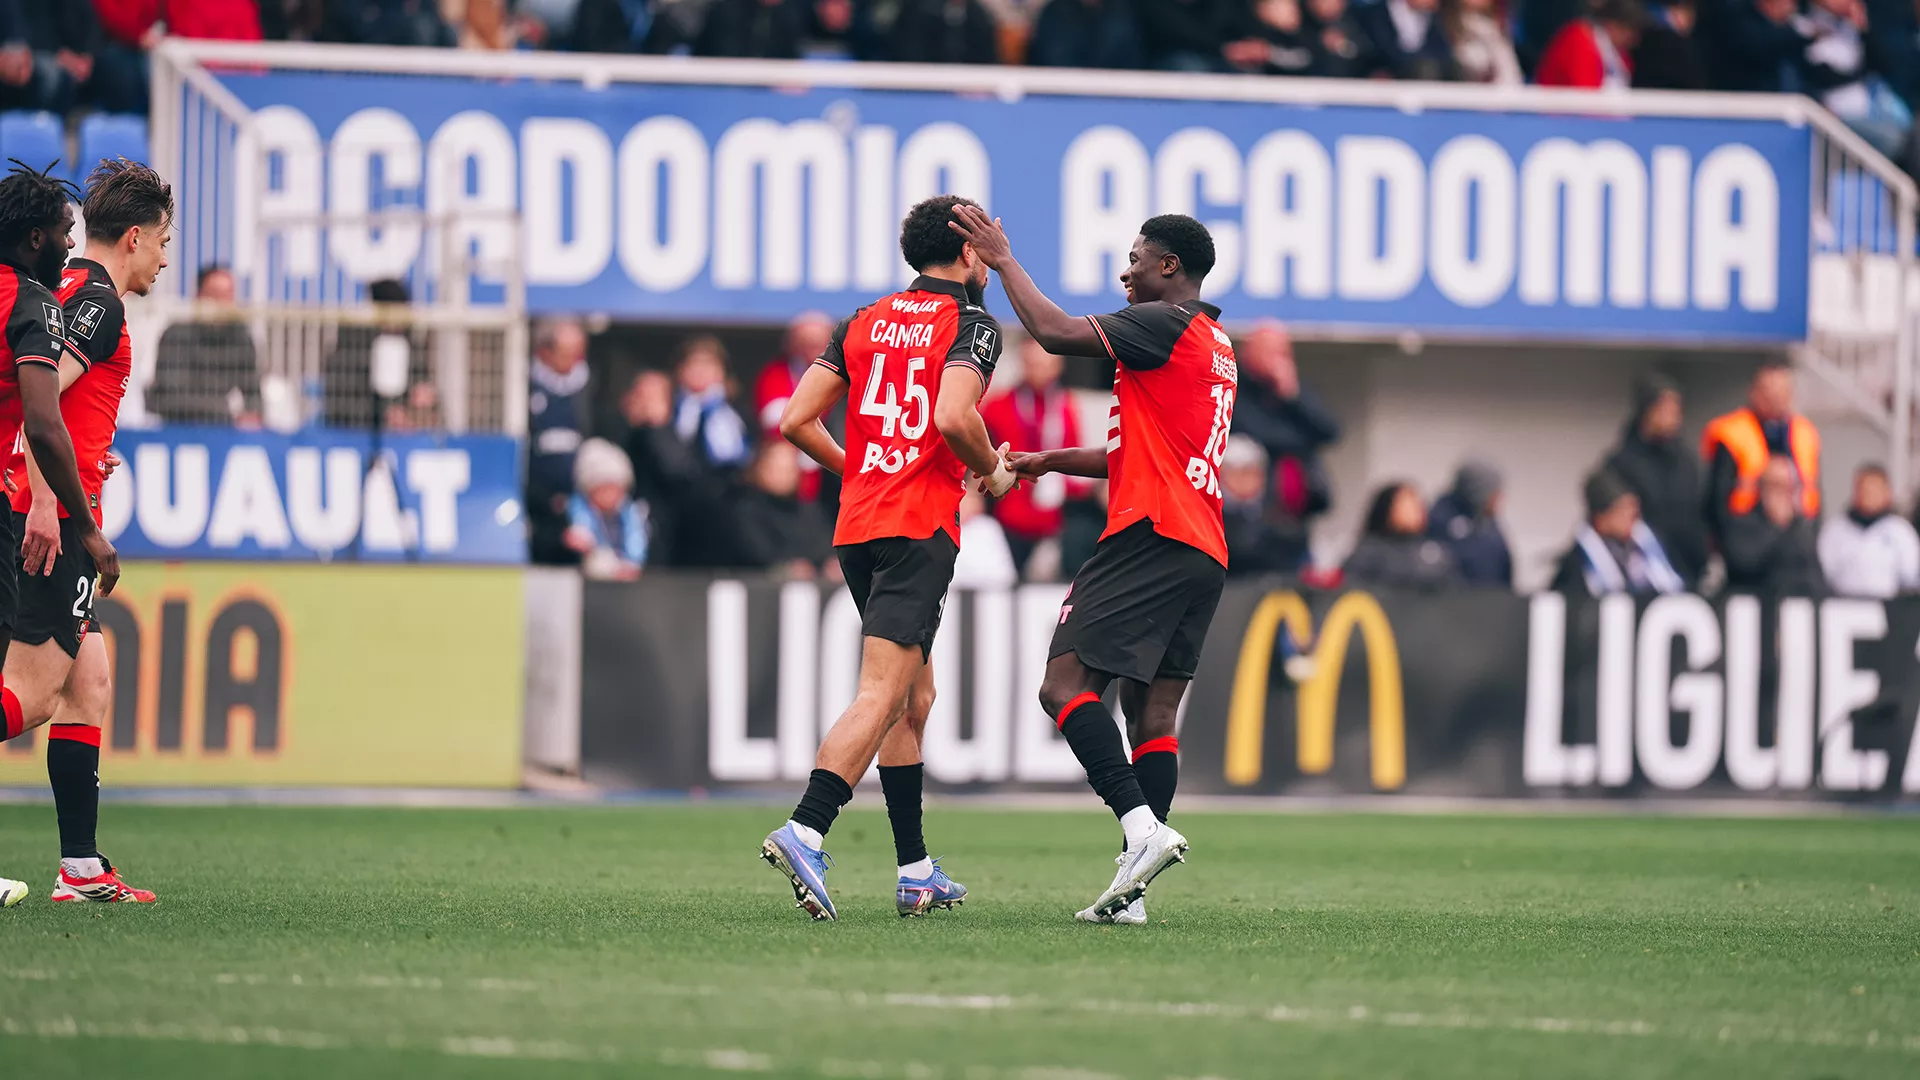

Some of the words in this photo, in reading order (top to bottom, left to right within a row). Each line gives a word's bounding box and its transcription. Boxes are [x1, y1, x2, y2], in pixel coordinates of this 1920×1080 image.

[1060, 125, 1780, 312] ACADOMIA
[859, 353, 930, 440] 45
[1203, 384, 1233, 468] 18
[1523, 590, 1889, 791] LIGUE
